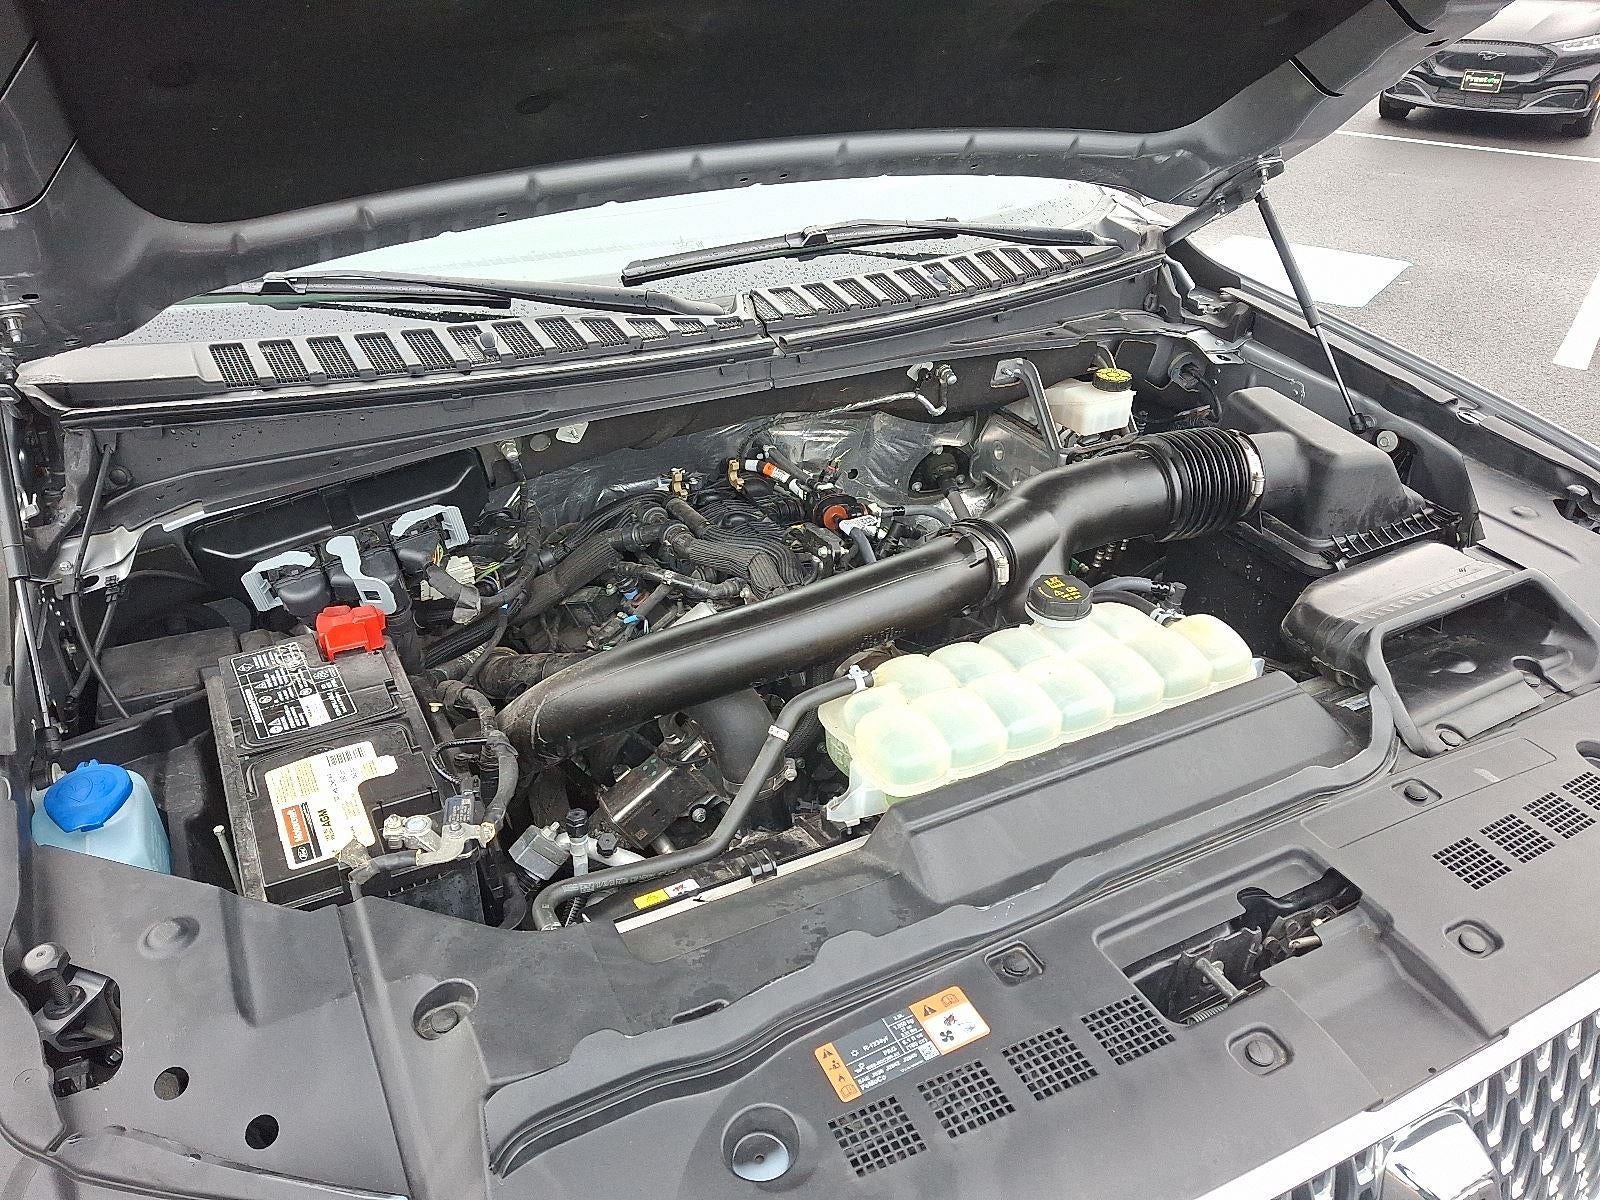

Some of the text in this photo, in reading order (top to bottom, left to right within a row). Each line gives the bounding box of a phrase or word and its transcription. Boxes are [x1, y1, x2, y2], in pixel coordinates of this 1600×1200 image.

[317, 807, 332, 829] AGM
[881, 1045, 898, 1055] PAG
[858, 1075, 888, 1091] FoMoCo
